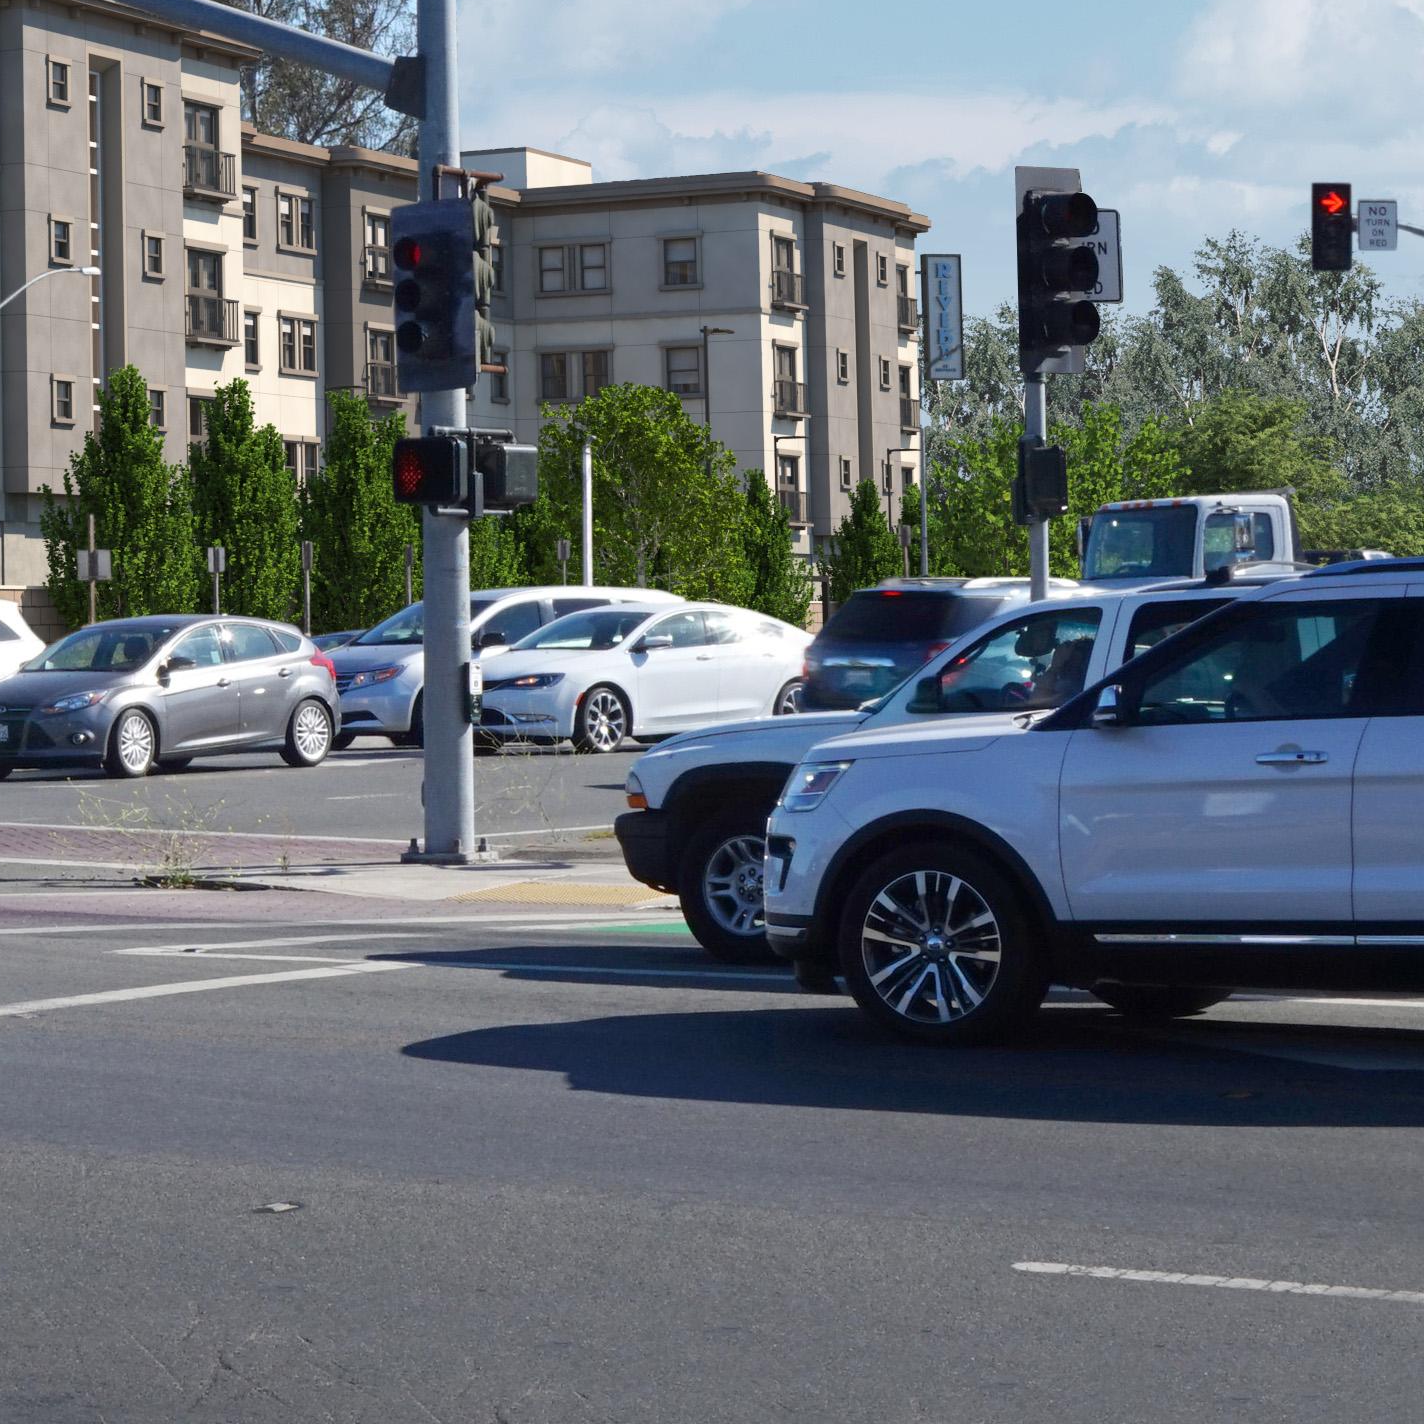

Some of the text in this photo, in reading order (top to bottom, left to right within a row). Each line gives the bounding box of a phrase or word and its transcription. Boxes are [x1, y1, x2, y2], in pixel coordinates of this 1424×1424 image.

[1368, 206, 1388, 217] NO
[1365, 217, 1391, 227] TURN
[1371, 228, 1385, 237] ON
[1369, 239, 1388, 248] RED
